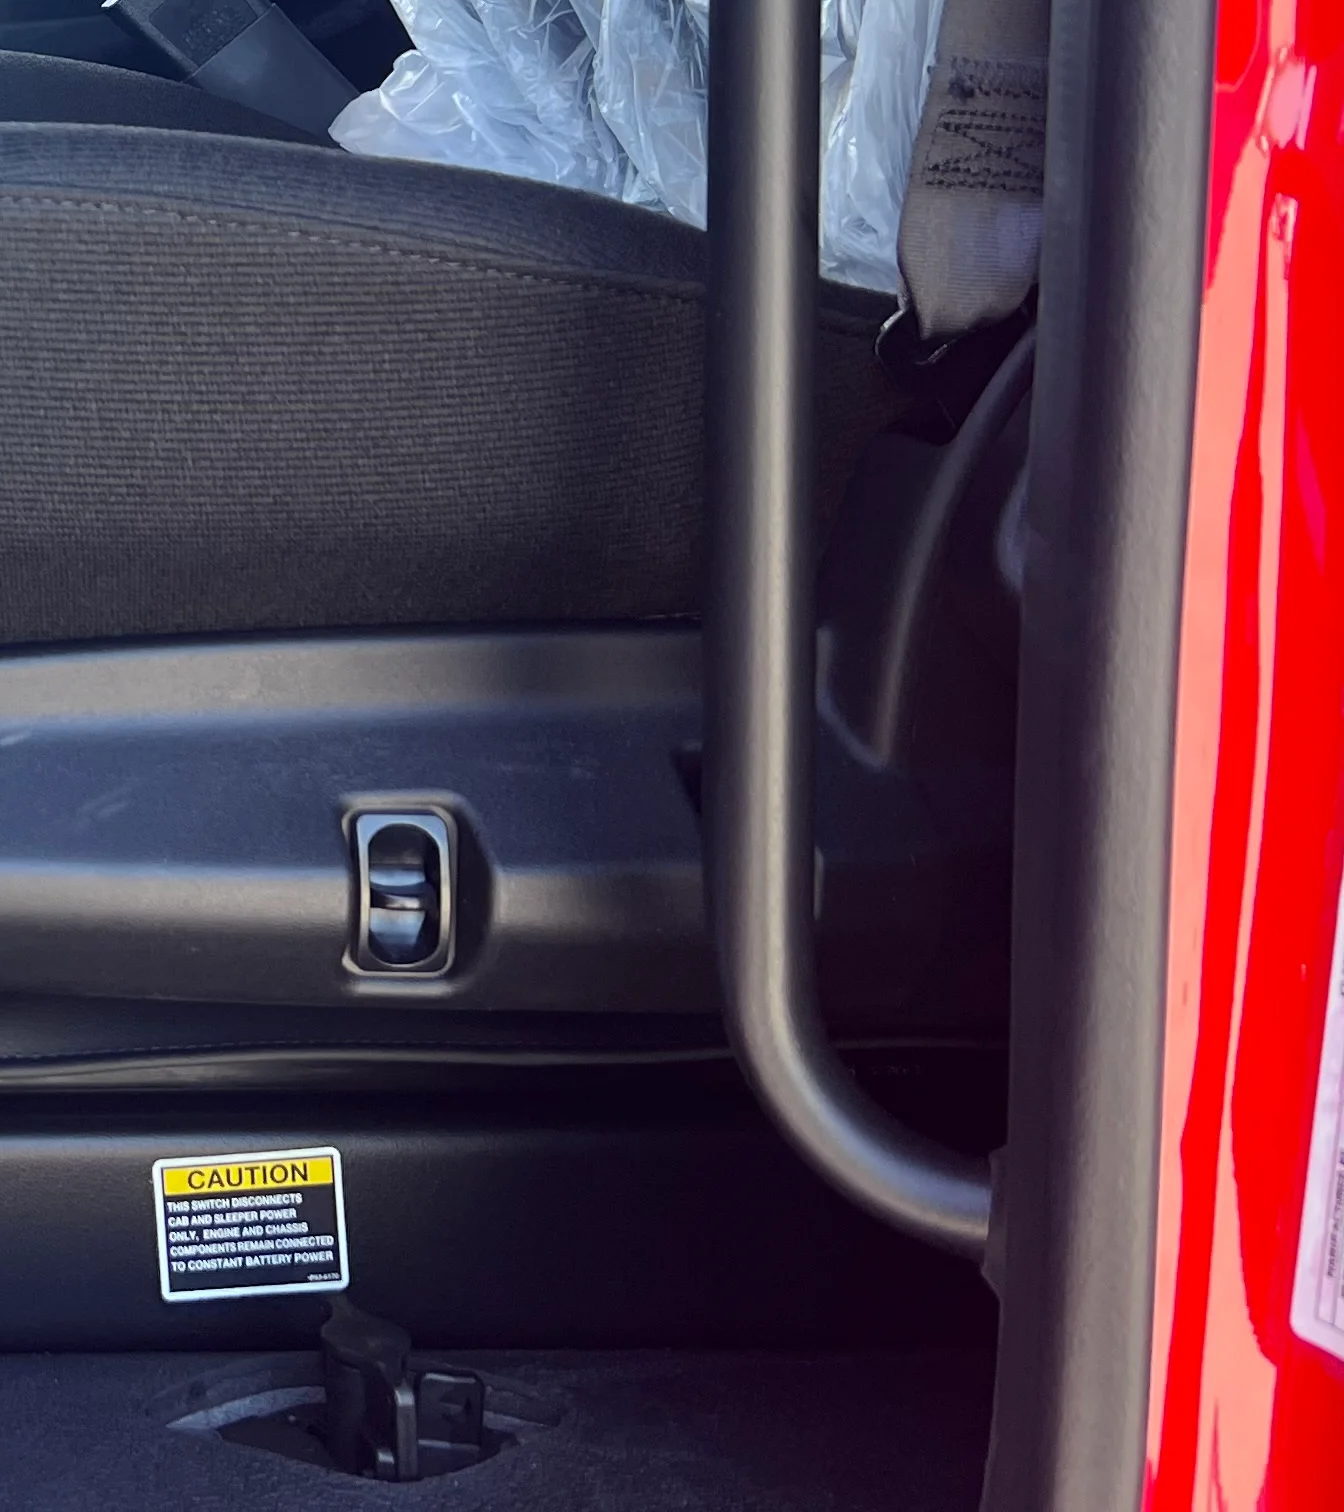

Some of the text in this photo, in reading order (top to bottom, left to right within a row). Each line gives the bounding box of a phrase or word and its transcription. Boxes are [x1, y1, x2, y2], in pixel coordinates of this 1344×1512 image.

[187, 1163, 308, 1190] CAUTION
[167, 1193, 302, 1212] THIS SWITCH DISCONNECTS
[168, 1208, 296, 1227] CAB AND SLEEPER POWER
[203, 1227, 240, 1239] ENGINE
[242, 1225, 263, 1237] AND
[265, 1222, 308, 1235] CHASSIS
[170, 1236, 334, 1257] COMPONENTS REMAIN CONNECTED
[171, 1251, 333, 1272] TO CONSTANT BATTERY POWER
